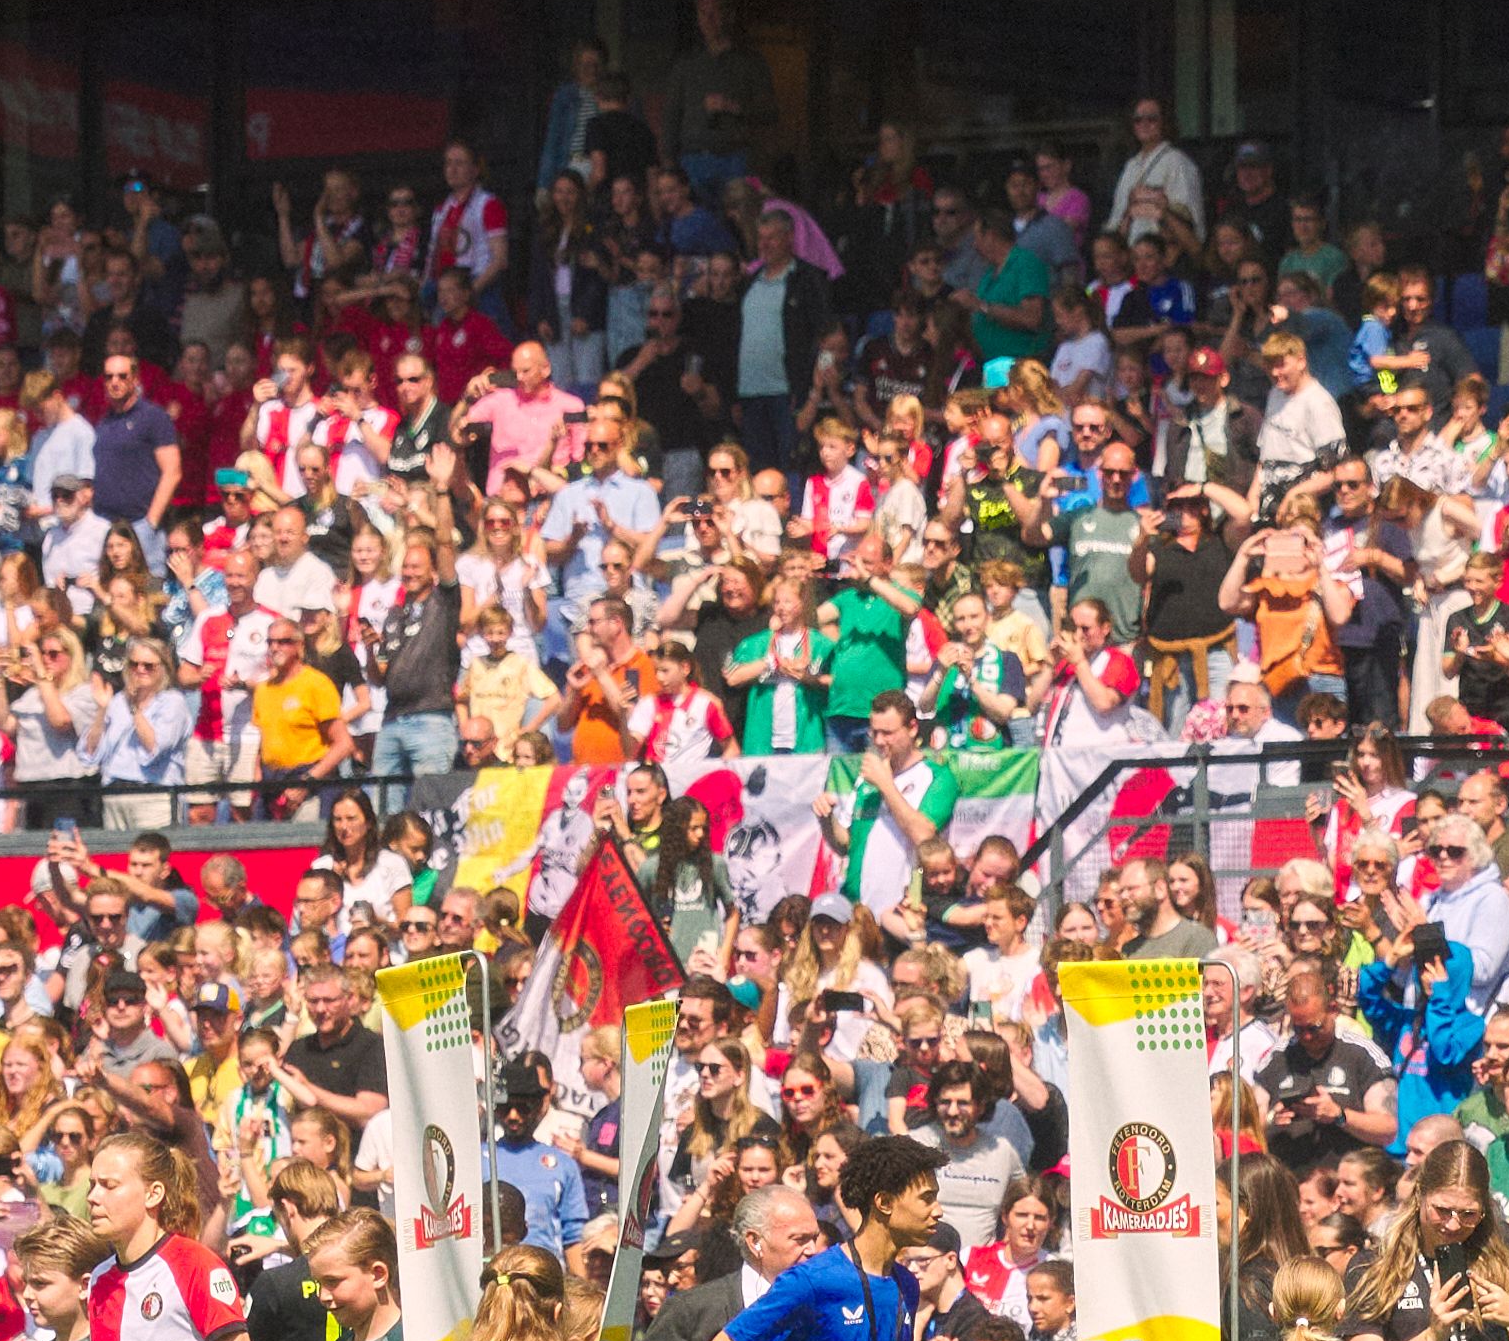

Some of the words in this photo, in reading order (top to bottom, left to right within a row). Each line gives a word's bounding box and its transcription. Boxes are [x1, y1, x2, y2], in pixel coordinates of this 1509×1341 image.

[1111, 1125, 1171, 1155] FEYENOORD
[1114, 1178, 1172, 1211] ROTTERDAM
[1103, 1201, 1188, 1230] KAMERAADJES
